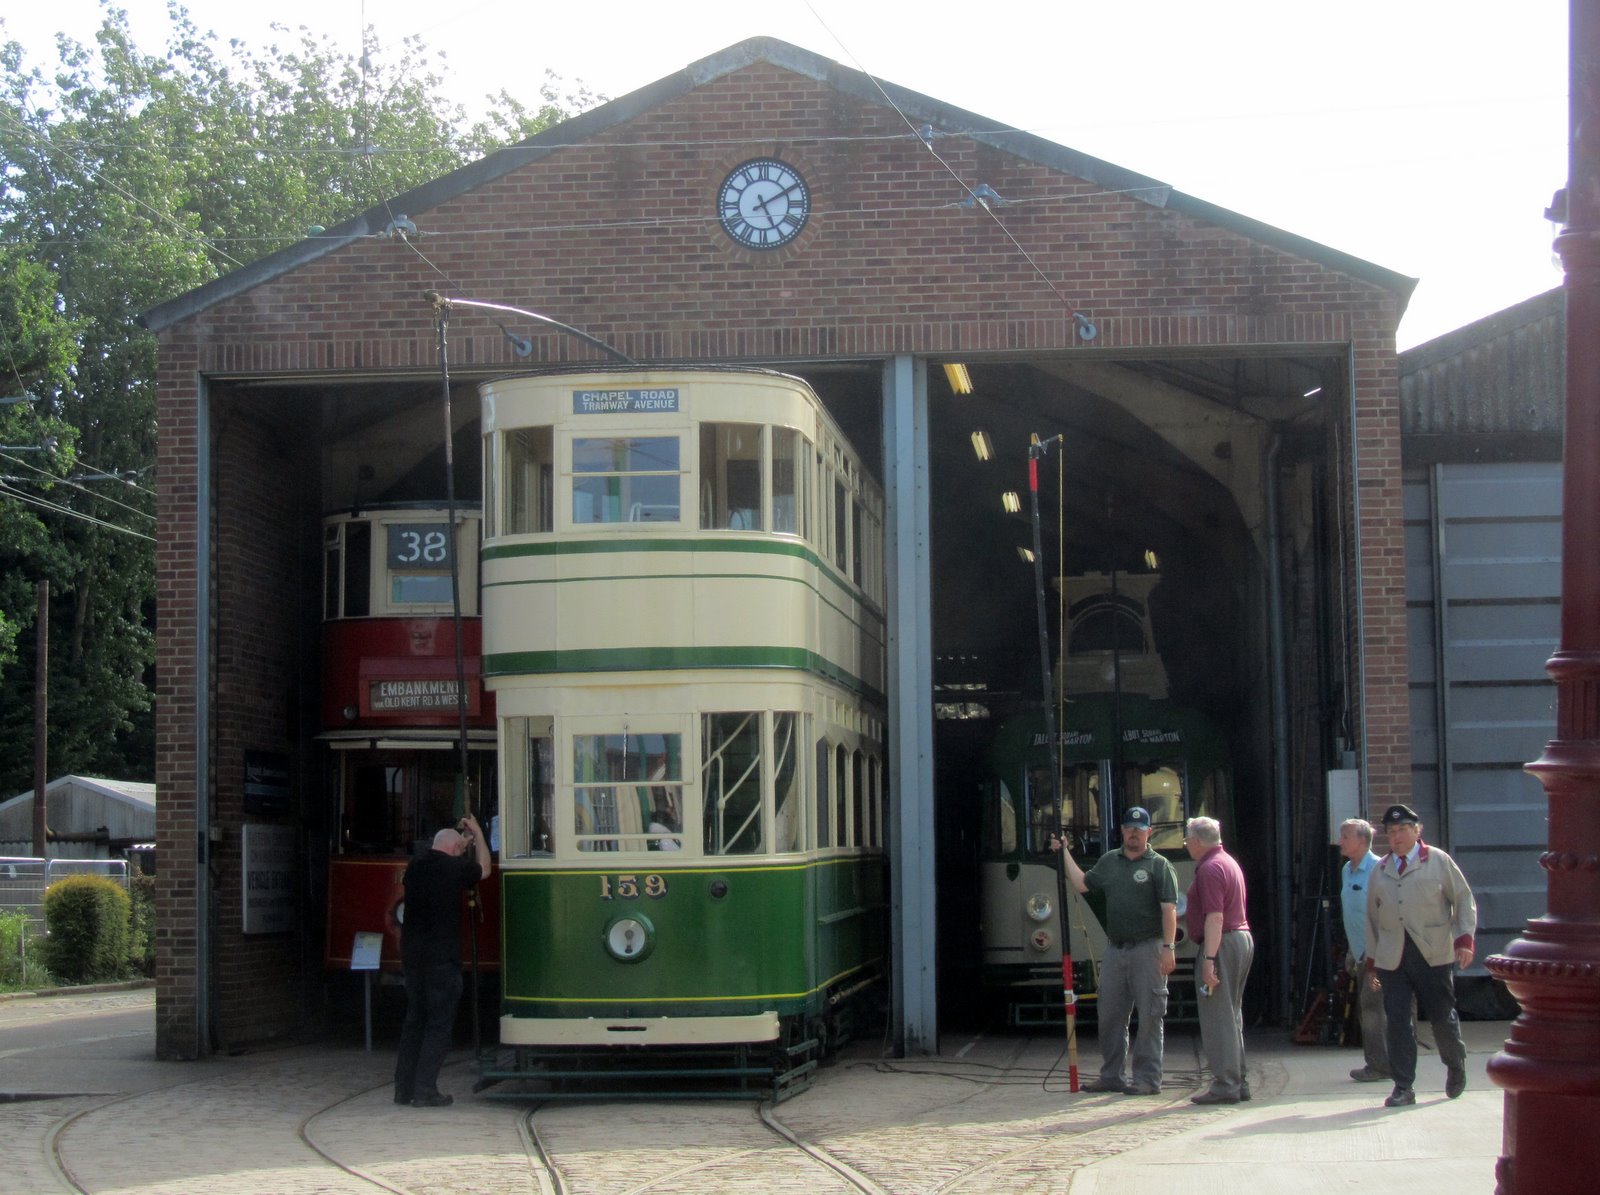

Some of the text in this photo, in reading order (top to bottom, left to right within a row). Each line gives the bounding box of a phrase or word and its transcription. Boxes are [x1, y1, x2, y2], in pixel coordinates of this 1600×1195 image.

[582, 390, 675, 401] CHAPEL ROAD
[583, 400, 675, 410] TRAMWAY AVENUE
[398, 531, 446, 562] 38
[384, 697, 399, 707] OLD
[401, 696, 420, 707] KENT
[423, 695, 432, 706] RD
[435, 695, 440, 705] &
[600, 874, 667, 899] 159
